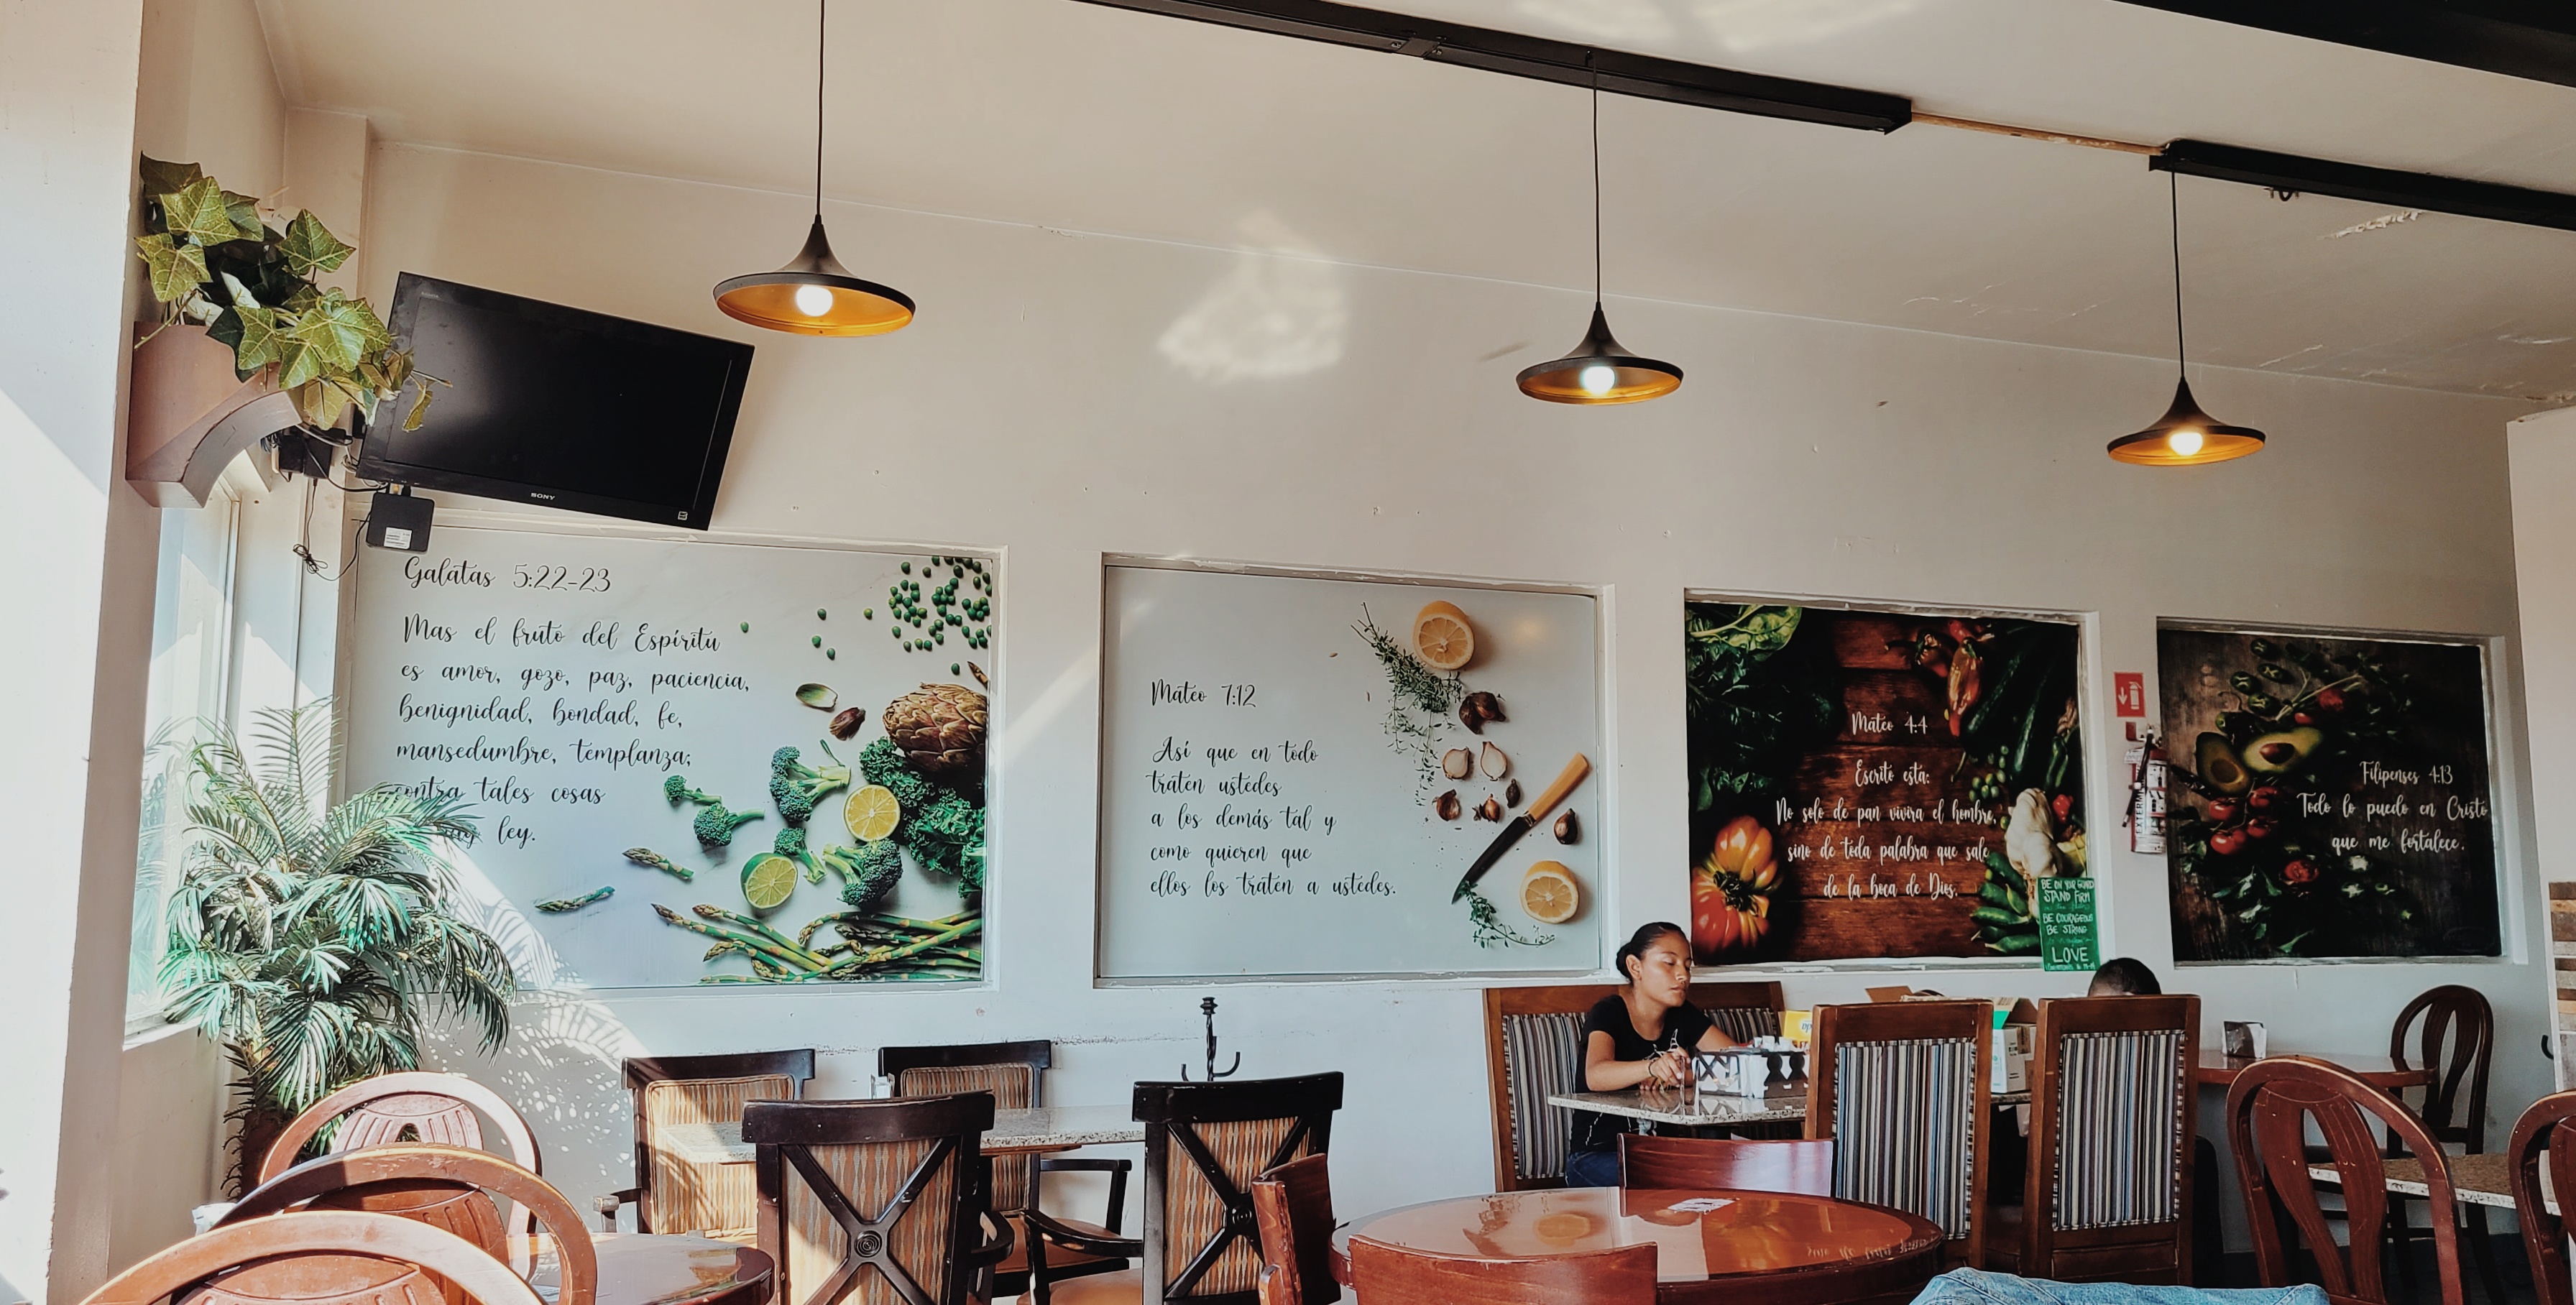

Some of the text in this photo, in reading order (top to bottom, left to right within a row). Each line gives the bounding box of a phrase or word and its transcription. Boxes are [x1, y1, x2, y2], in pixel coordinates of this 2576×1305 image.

[405, 556, 611, 592] Galatas 5:22-23
[404, 614, 720, 655] Mas el fruto del Espíritu
[402, 664, 749, 693] es amor, gozo, paz, paciencia,
[1151, 679, 1256, 708] Mateo 7:12
[399, 693, 681, 729] benignidad, bondad, fe,
[1852, 711, 1928, 735] Mateo 4:4
[397, 735, 691, 772] mansedumbre, templanza;
[1153, 736, 1318, 767] Así que en todo
[1146, 770, 1282, 796] traten ustedes
[1855, 759, 1930, 787] Escrito esta:
[2360, 761, 2453, 788] Filipenses 4:13
[395, 776, 605, 804] contra tales cosas
[1151, 803, 1337, 835] a los demás tal y
[1776, 797, 1997, 827] No solo de pan vivira el hombre,
[2296, 793, 2488, 822] Todo lo puedo en Cristo
[499, 816, 535, 849] ley.
[2332, 828, 2465, 856] que me fortalece.
[1150, 844, 1312, 867] como quieren que
[1788, 835, 1990, 866] sino de toda palabra que sale
[1150, 870, 1395, 898] ellos los traten a ustedes.
[1823, 872, 1958, 900] de la boca de Dios.
[2041, 879, 2052, 890] BE
[2043, 890, 2091, 904] STAND FIRM
[2043, 913, 2094, 924] BE COURAGEOUS
[2046, 924, 2088, 936] BE STRONG
[2051, 946, 2089, 963] LOVE
